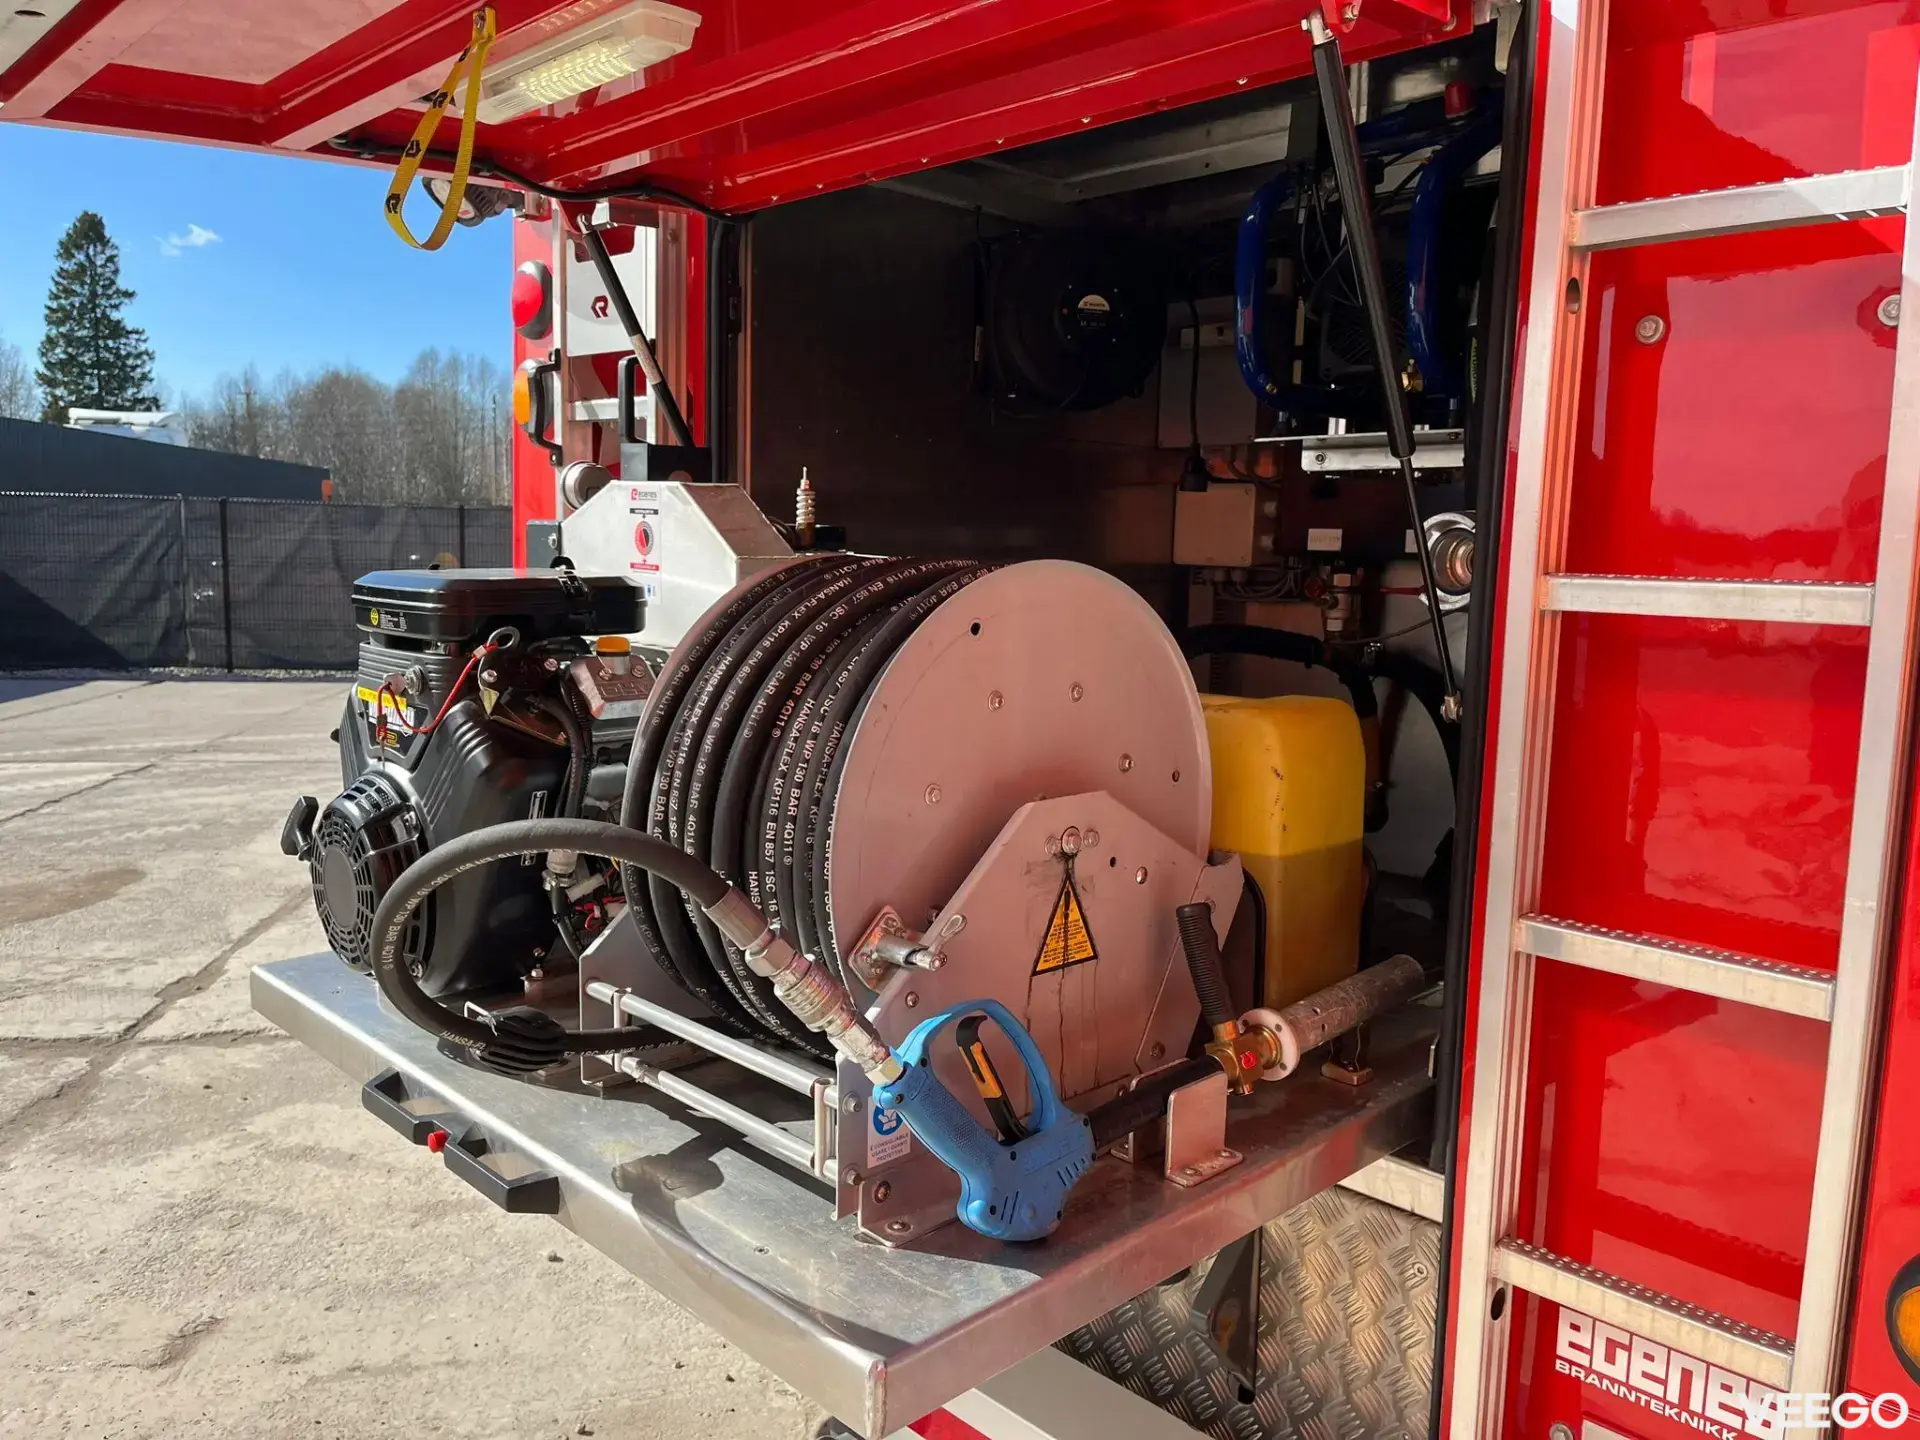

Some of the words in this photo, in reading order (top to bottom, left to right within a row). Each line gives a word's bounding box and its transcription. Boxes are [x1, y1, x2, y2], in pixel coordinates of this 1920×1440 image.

[886, 567, 917, 584] KP116
[852, 589, 870, 605] 857
[868, 581, 885, 593] EN
[939, 581, 959, 597] BAR
[791, 577, 853, 620] HANSA-FLEX
[829, 603, 849, 620] 1SC
[762, 619, 792, 648] KP116
[815, 621, 829, 633] 16
[800, 633, 817, 651] WP
[748, 650, 763, 666] EN
[783, 650, 801, 668] 130
[810, 653, 826, 670] 130
[736, 664, 751, 684] 857
[764, 669, 786, 696] BAR
[792, 672, 812, 696] BAR
[690, 655, 733, 724] HANSA-FLEX
[720, 689, 736, 711] 1SC
[776, 698, 795, 727] 4Q11
[820, 693, 836, 716] 1SC
[711, 715, 723, 729] 16
[811, 720, 823, 734] 16
[704, 733, 716, 753] WP
[778, 697, 816, 773] HANSA-FLEX
[677, 728, 695, 765] KP116
[802, 739, 817, 760] WP
[696, 757, 707, 776] 130
[813, 720, 846, 798] HANSA-FLEX
[659, 771, 671, 790] 130
[673, 770, 682, 788] EN
[793, 762, 808, 783] 130
[689, 782, 702, 809] BAR
[768, 778, 785, 816] KP116
[787, 788, 801, 816] BAR
[653, 795, 667, 820] BAR
[669, 815, 679, 838] 1SC
[686, 813, 697, 843] 4Q11
[765, 821, 777, 840] EN
[783, 821, 795, 852] 4Q11
[764, 841, 775, 864] 857
[764, 870, 776, 893] 1SC
[768, 898, 779, 913] 16
[385, 925, 401, 942] BAR
[1555, 1359, 1738, 1440] BRANNTEKNIKK
